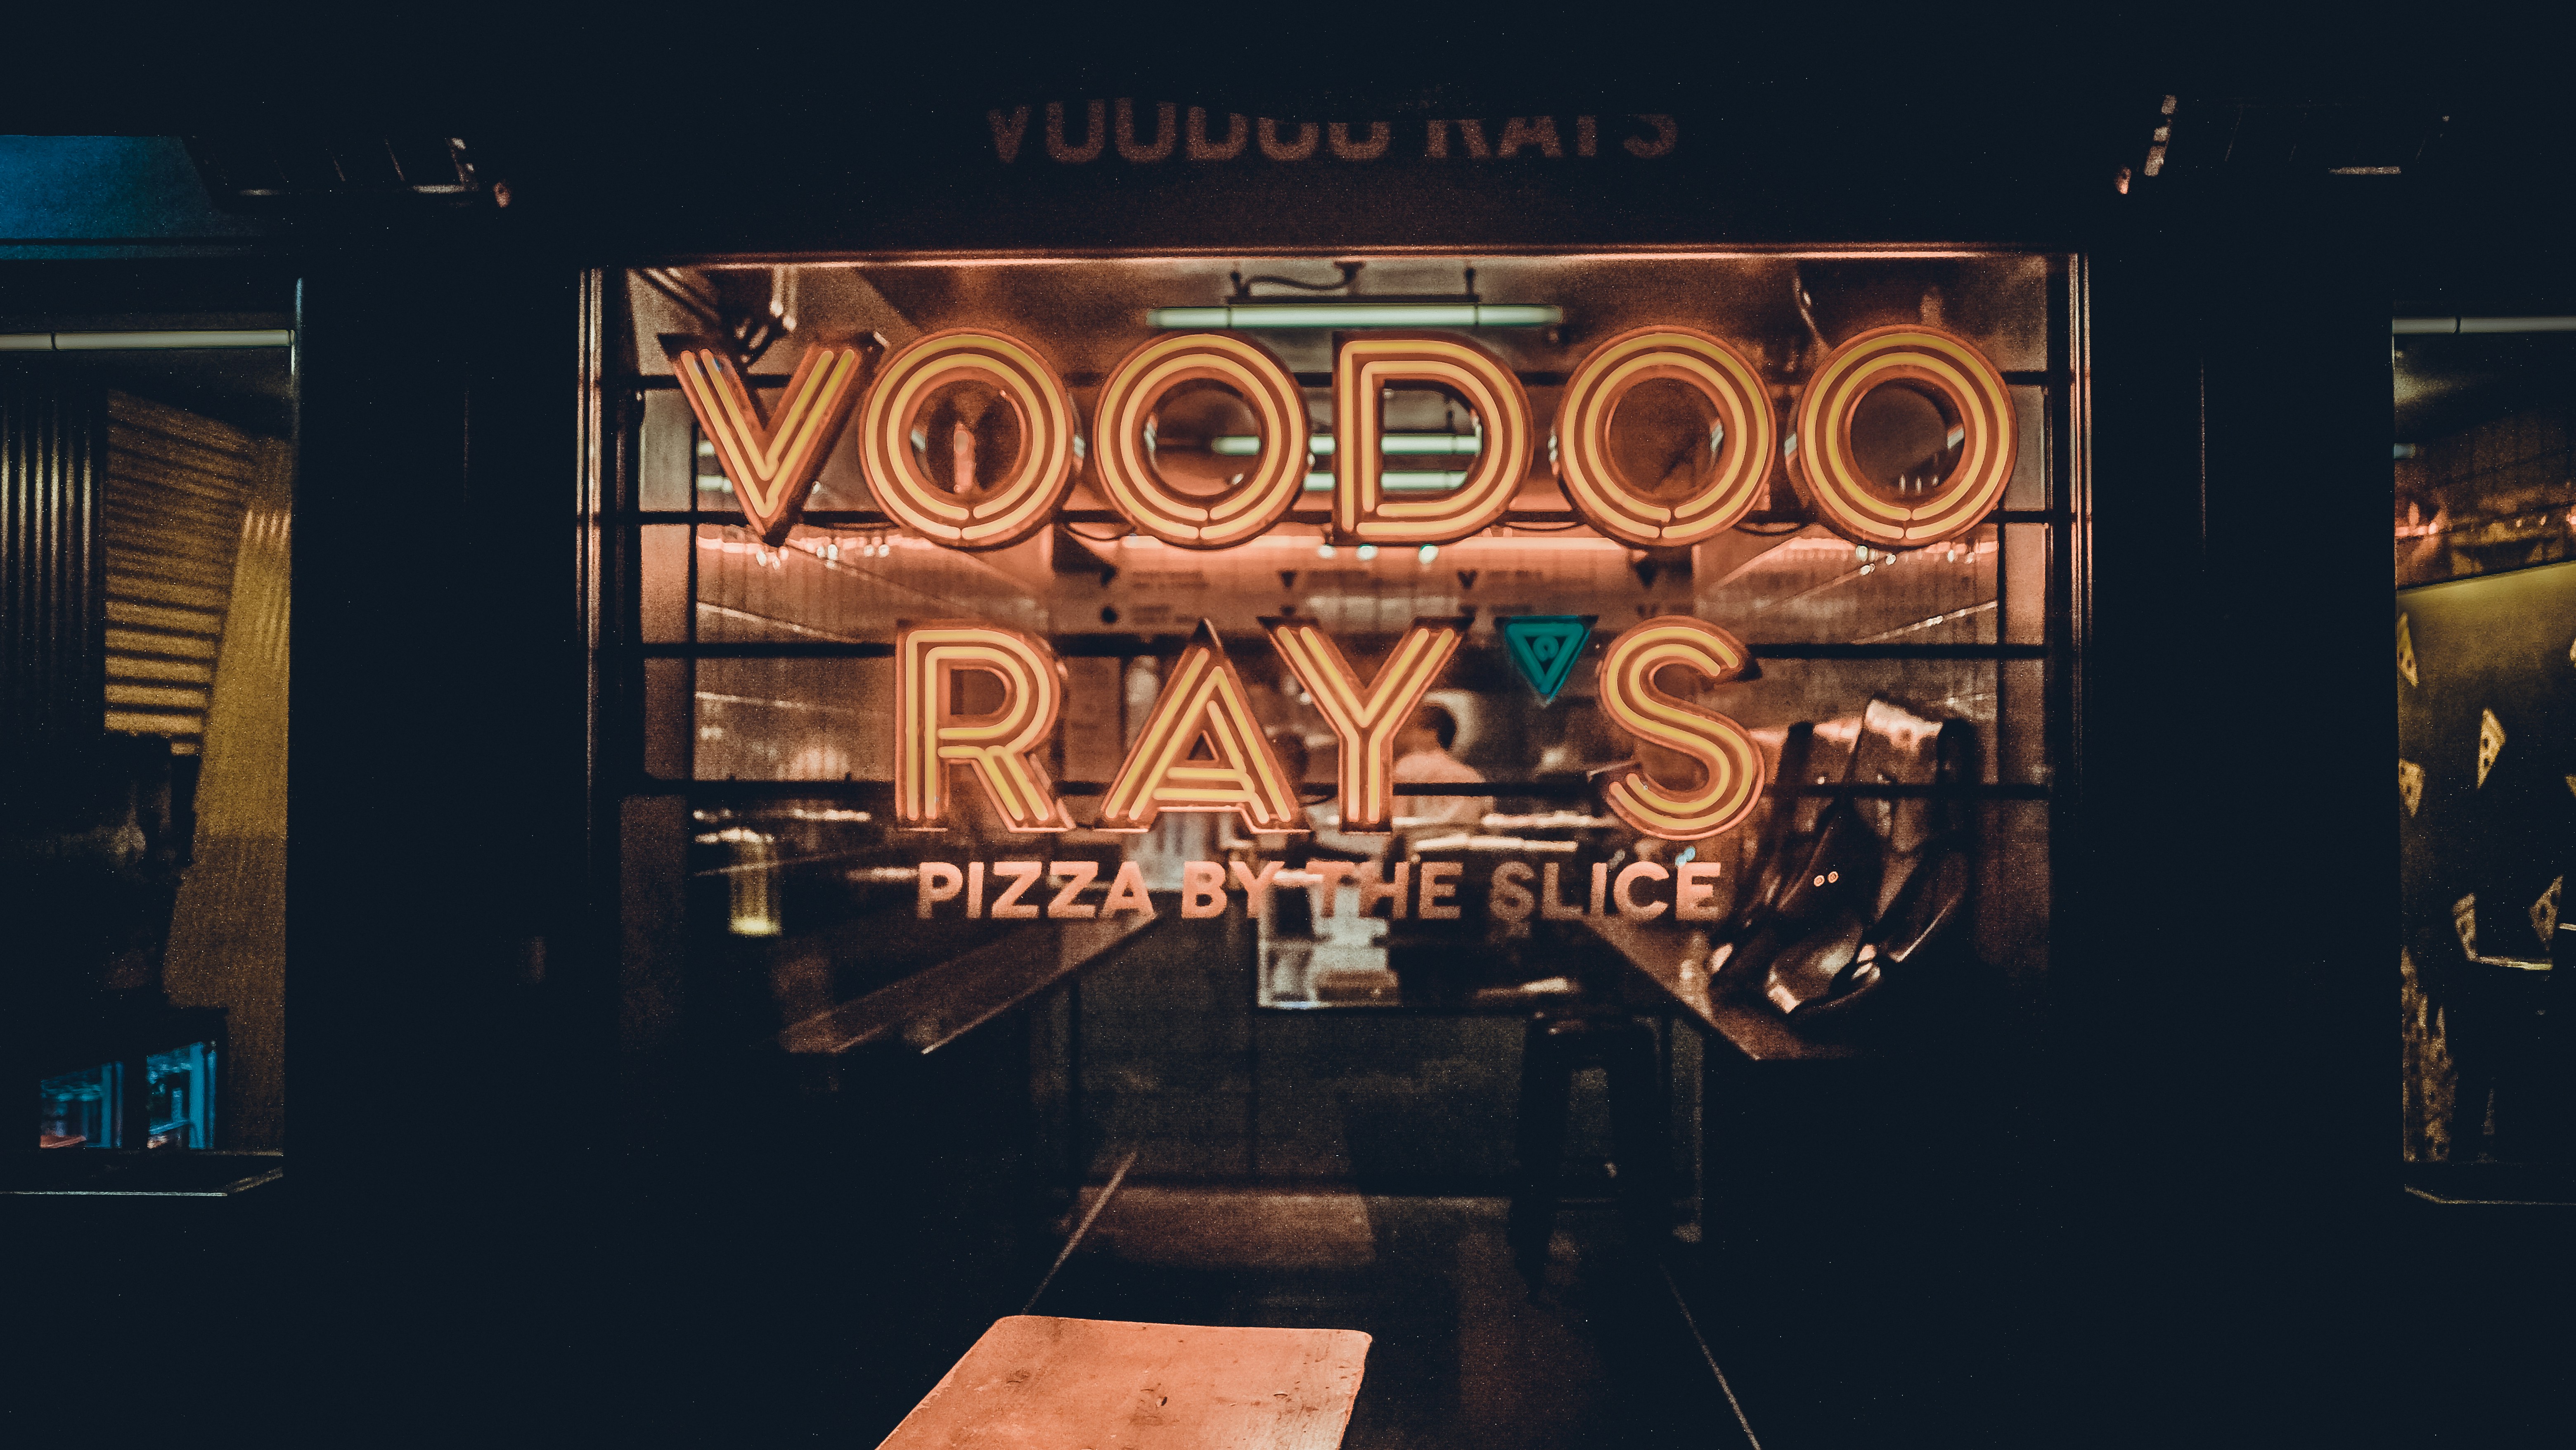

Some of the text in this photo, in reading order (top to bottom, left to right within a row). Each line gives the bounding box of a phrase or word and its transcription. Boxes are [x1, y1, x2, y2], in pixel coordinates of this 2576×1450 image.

[658, 323, 2020, 550] VOODOO
[895, 615, 1765, 841] RAY'S
[916, 860, 1722, 921] PIZZA BY THE SLICE
